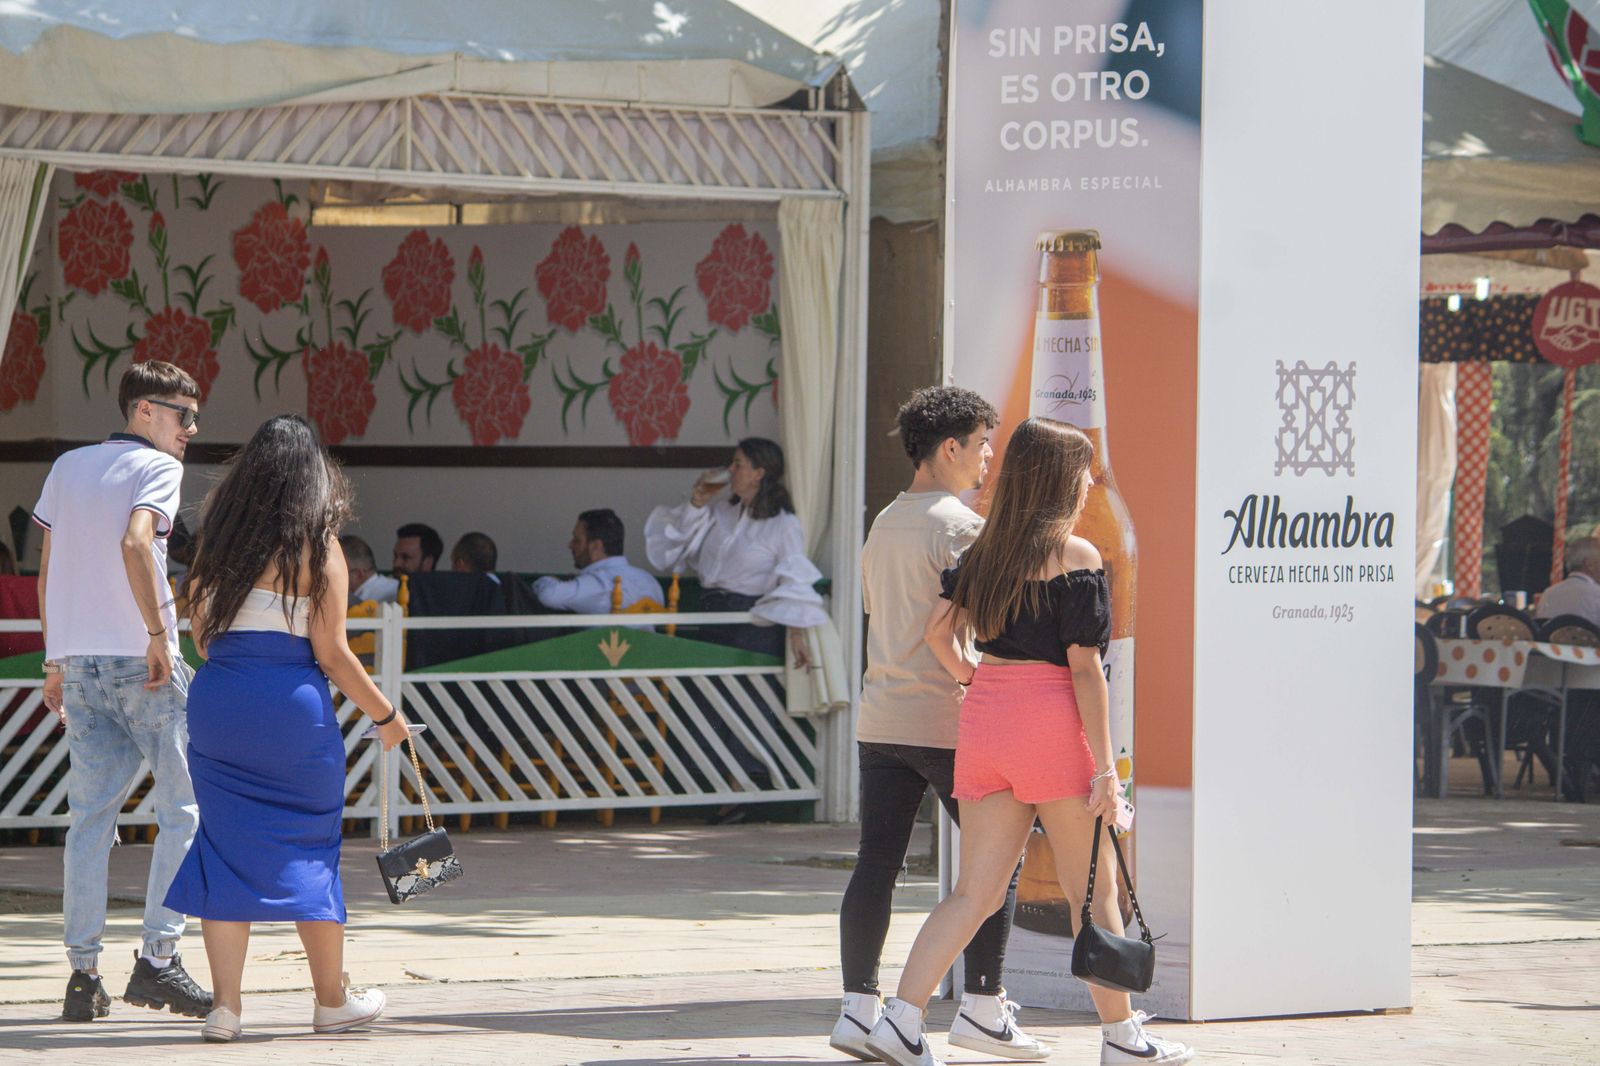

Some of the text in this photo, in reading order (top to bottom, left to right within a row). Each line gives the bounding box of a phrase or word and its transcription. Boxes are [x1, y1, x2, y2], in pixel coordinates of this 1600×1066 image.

[989, 22, 1165, 58] SIN PRISA,
[1001, 69, 1151, 104] ES OTRO
[1000, 118, 1149, 151] CORPUS.
[984, 176, 1163, 193] ALHAMBRA ESPECIAL
[1546, 296, 1600, 330] UGT
[1221, 494, 1395, 556] Alhambra
[1228, 564, 1395, 584] CERVEZA HECHA SIN PRISA
